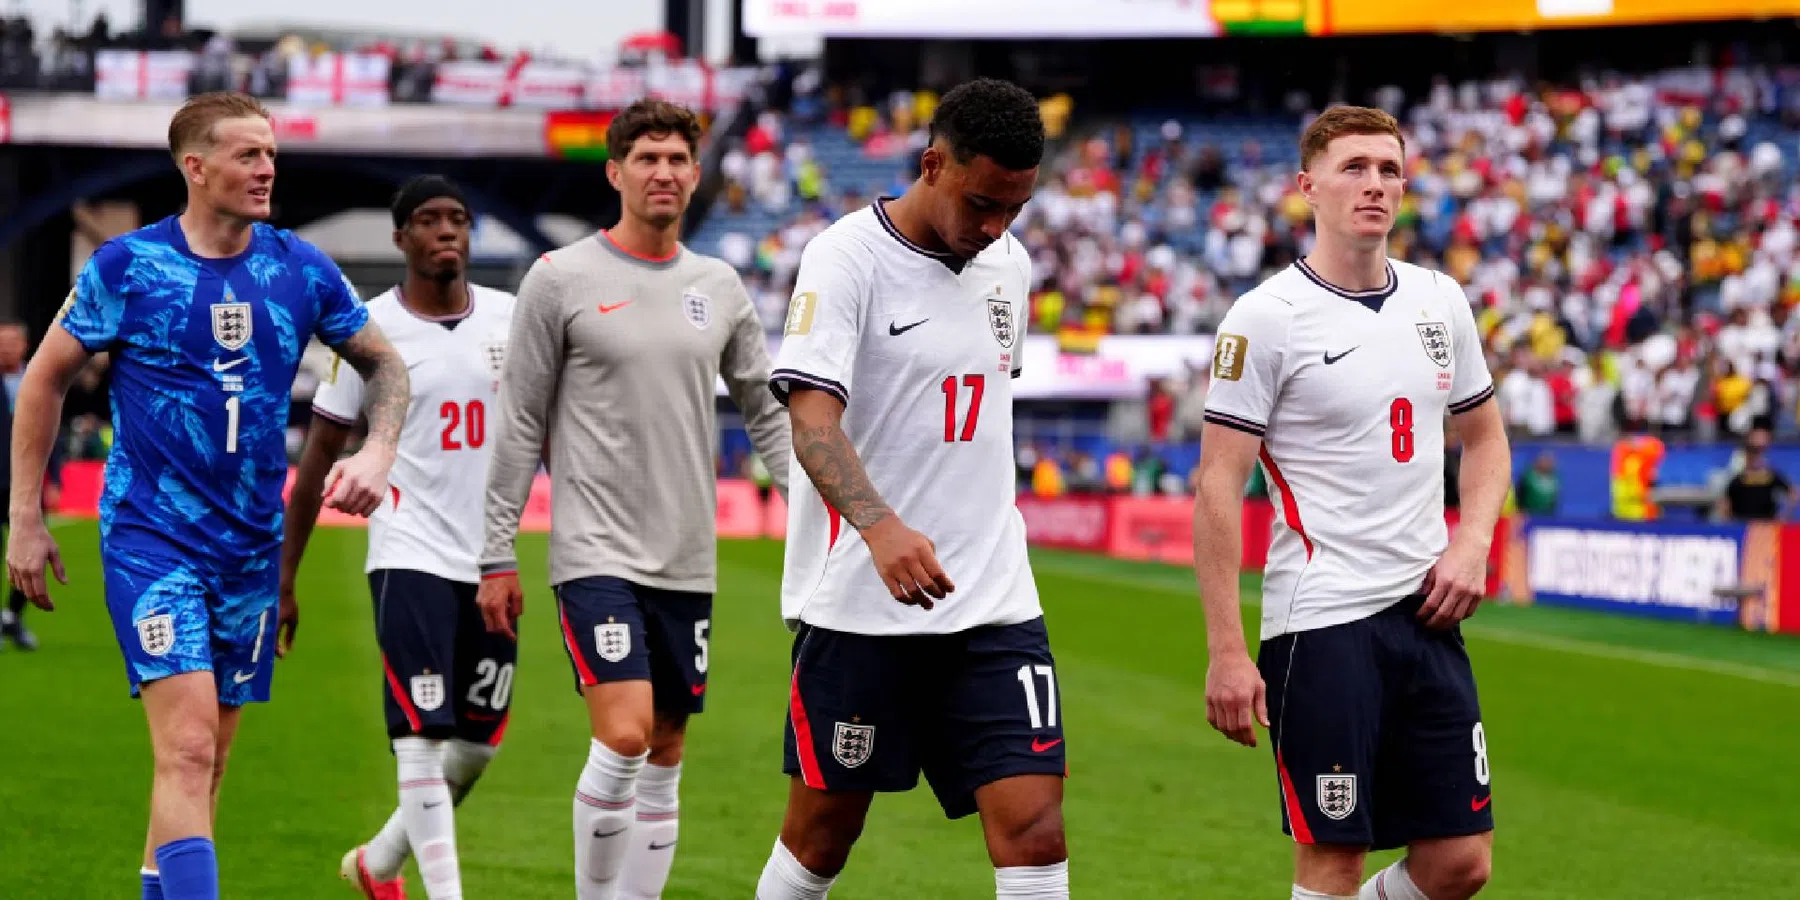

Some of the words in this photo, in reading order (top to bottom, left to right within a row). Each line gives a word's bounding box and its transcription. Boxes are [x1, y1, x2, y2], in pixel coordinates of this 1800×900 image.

[226, 396, 239, 454] 1
[440, 400, 484, 450] 20
[941, 374, 984, 442] 17
[1390, 398, 1414, 463] 8
[694, 619, 709, 673] 5
[466, 658, 515, 710] 20
[1018, 665, 1056, 728] 17
[1472, 722, 1490, 786] 8
